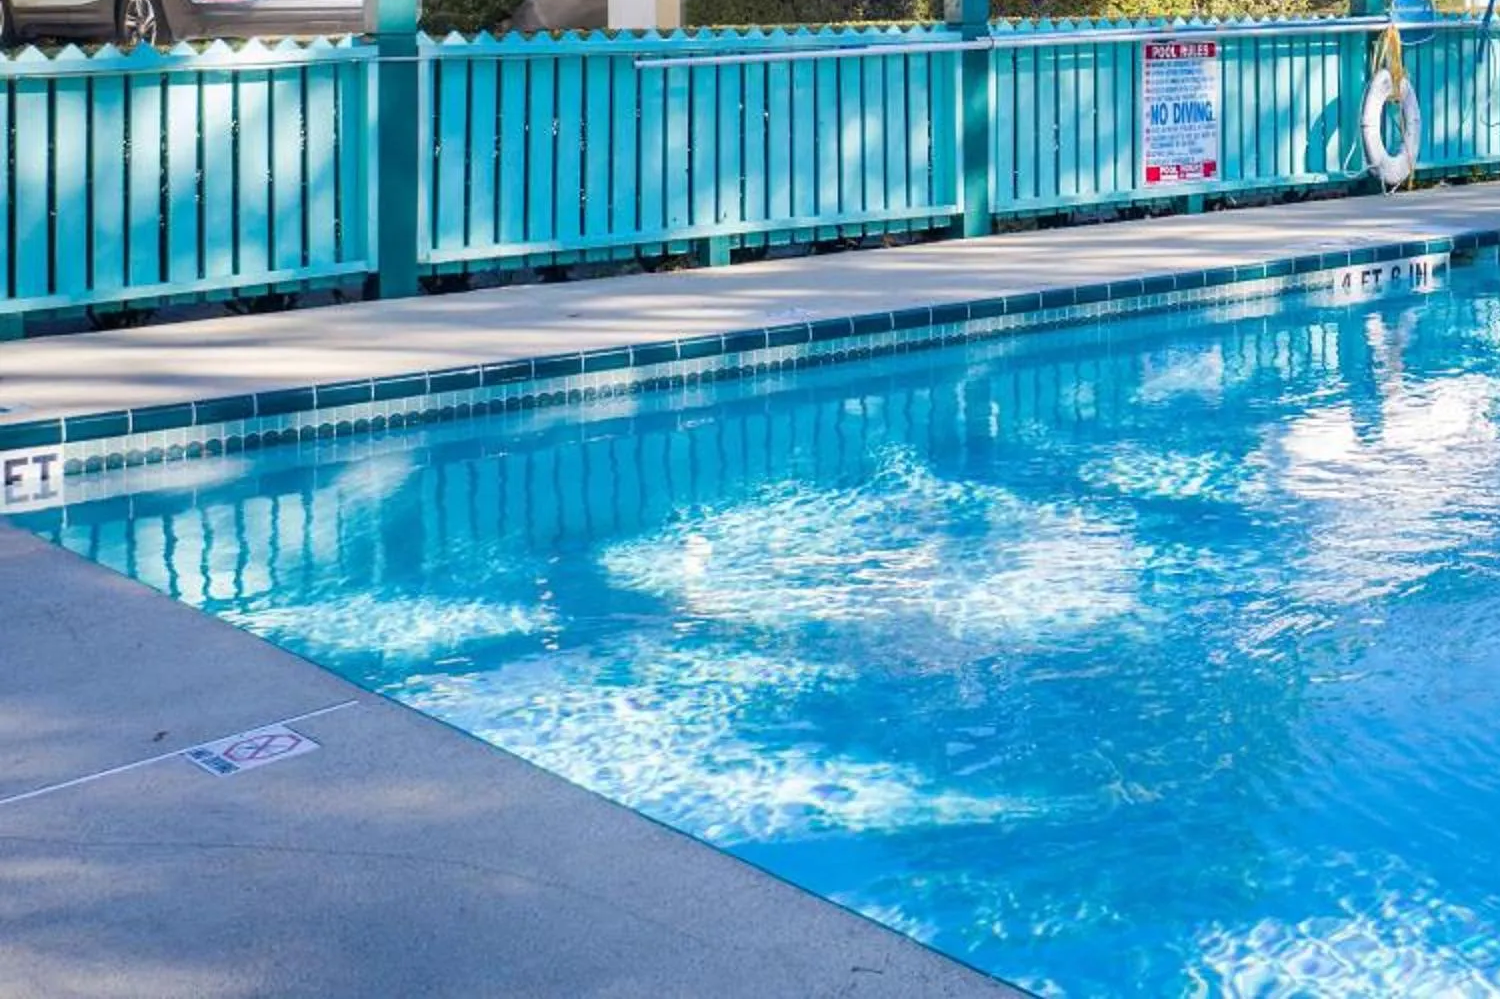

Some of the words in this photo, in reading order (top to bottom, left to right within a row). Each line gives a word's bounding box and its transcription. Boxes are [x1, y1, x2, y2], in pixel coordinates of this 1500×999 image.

[1151, 45, 1177, 58] POOL
[1180, 44, 1209, 57] RULES
[1150, 102, 1168, 125] NO
[1173, 100, 1214, 124] DIVING
[1361, 268, 1383, 285] FT
[4, 453, 58, 485] FT
